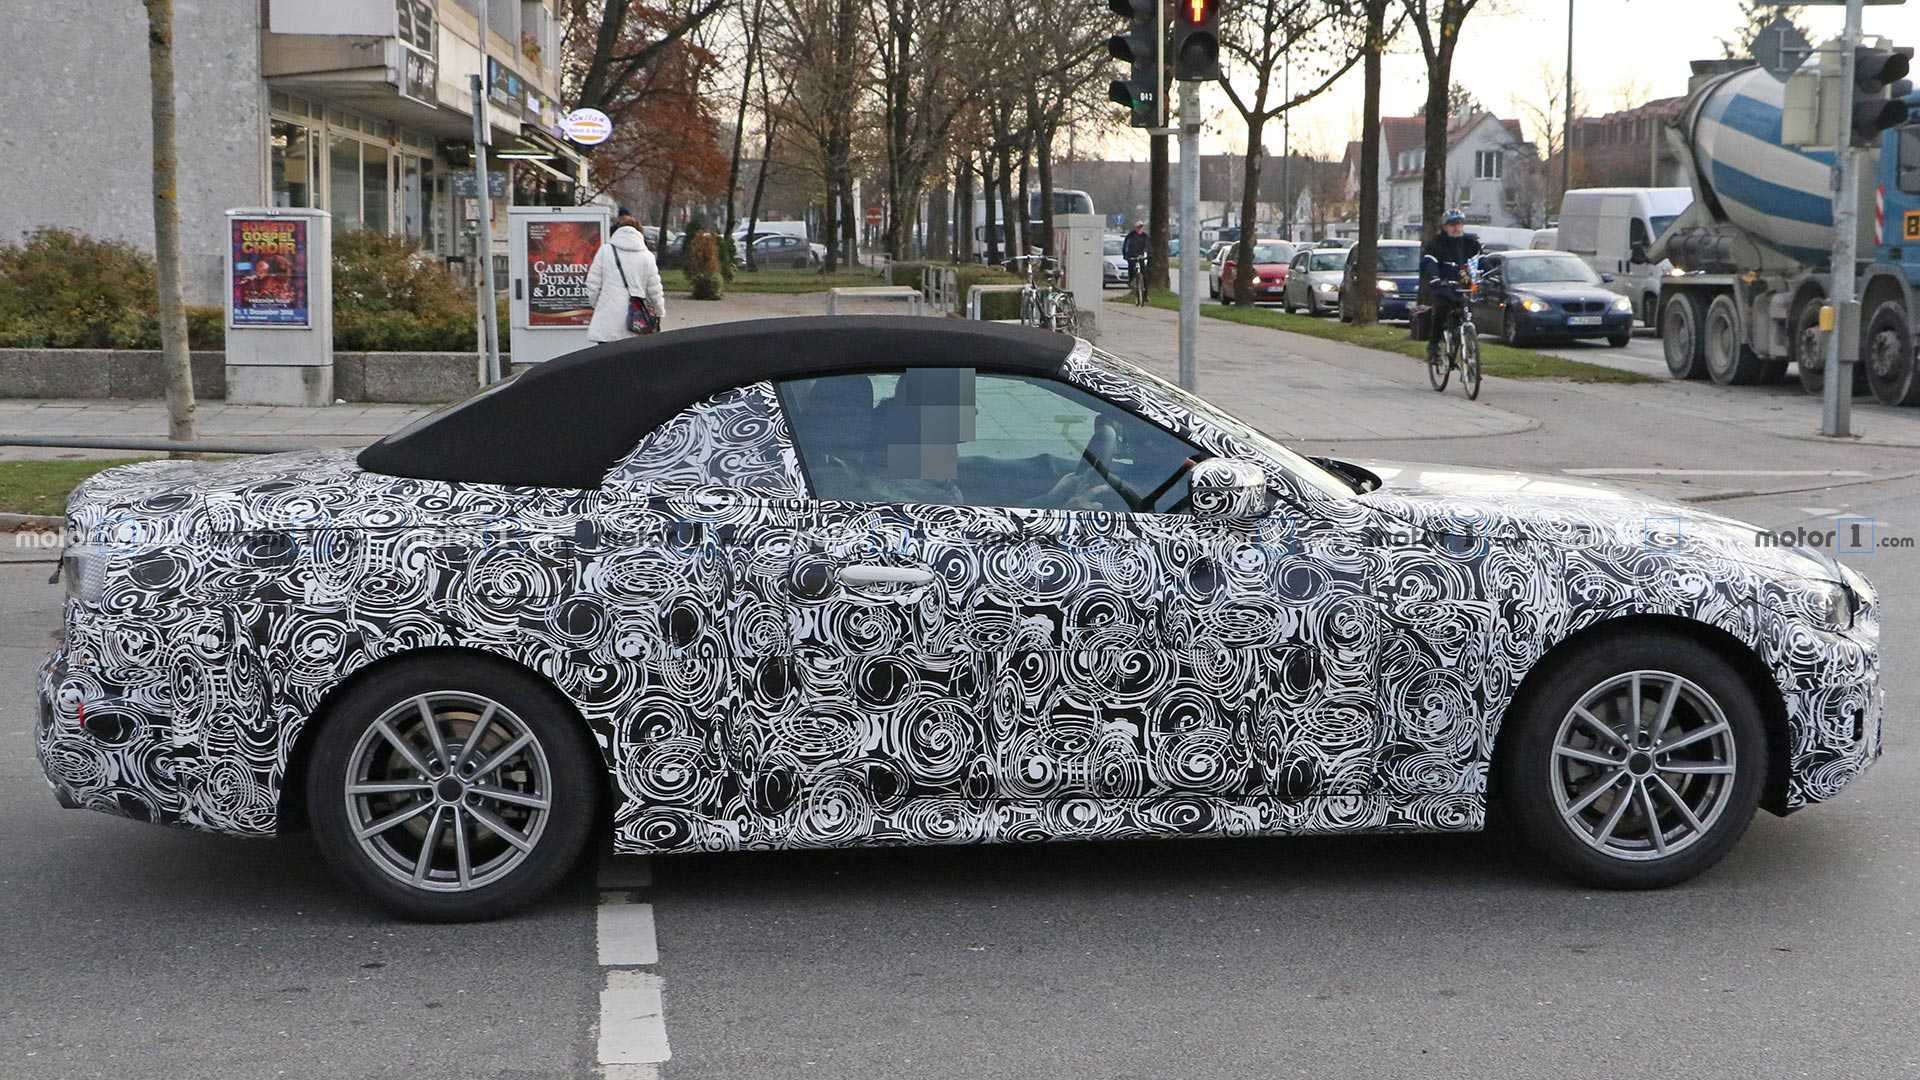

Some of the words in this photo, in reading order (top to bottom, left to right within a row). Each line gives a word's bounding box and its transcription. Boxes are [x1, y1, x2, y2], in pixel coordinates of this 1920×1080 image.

[242, 232, 296, 242] GOSPEL
[242, 242, 297, 255] CHOIR
[534, 260, 589, 273] CARMIN
[539, 272, 585, 285] BURAN
[533, 287, 544, 297] &
[547, 283, 592, 297] BOLÉR
